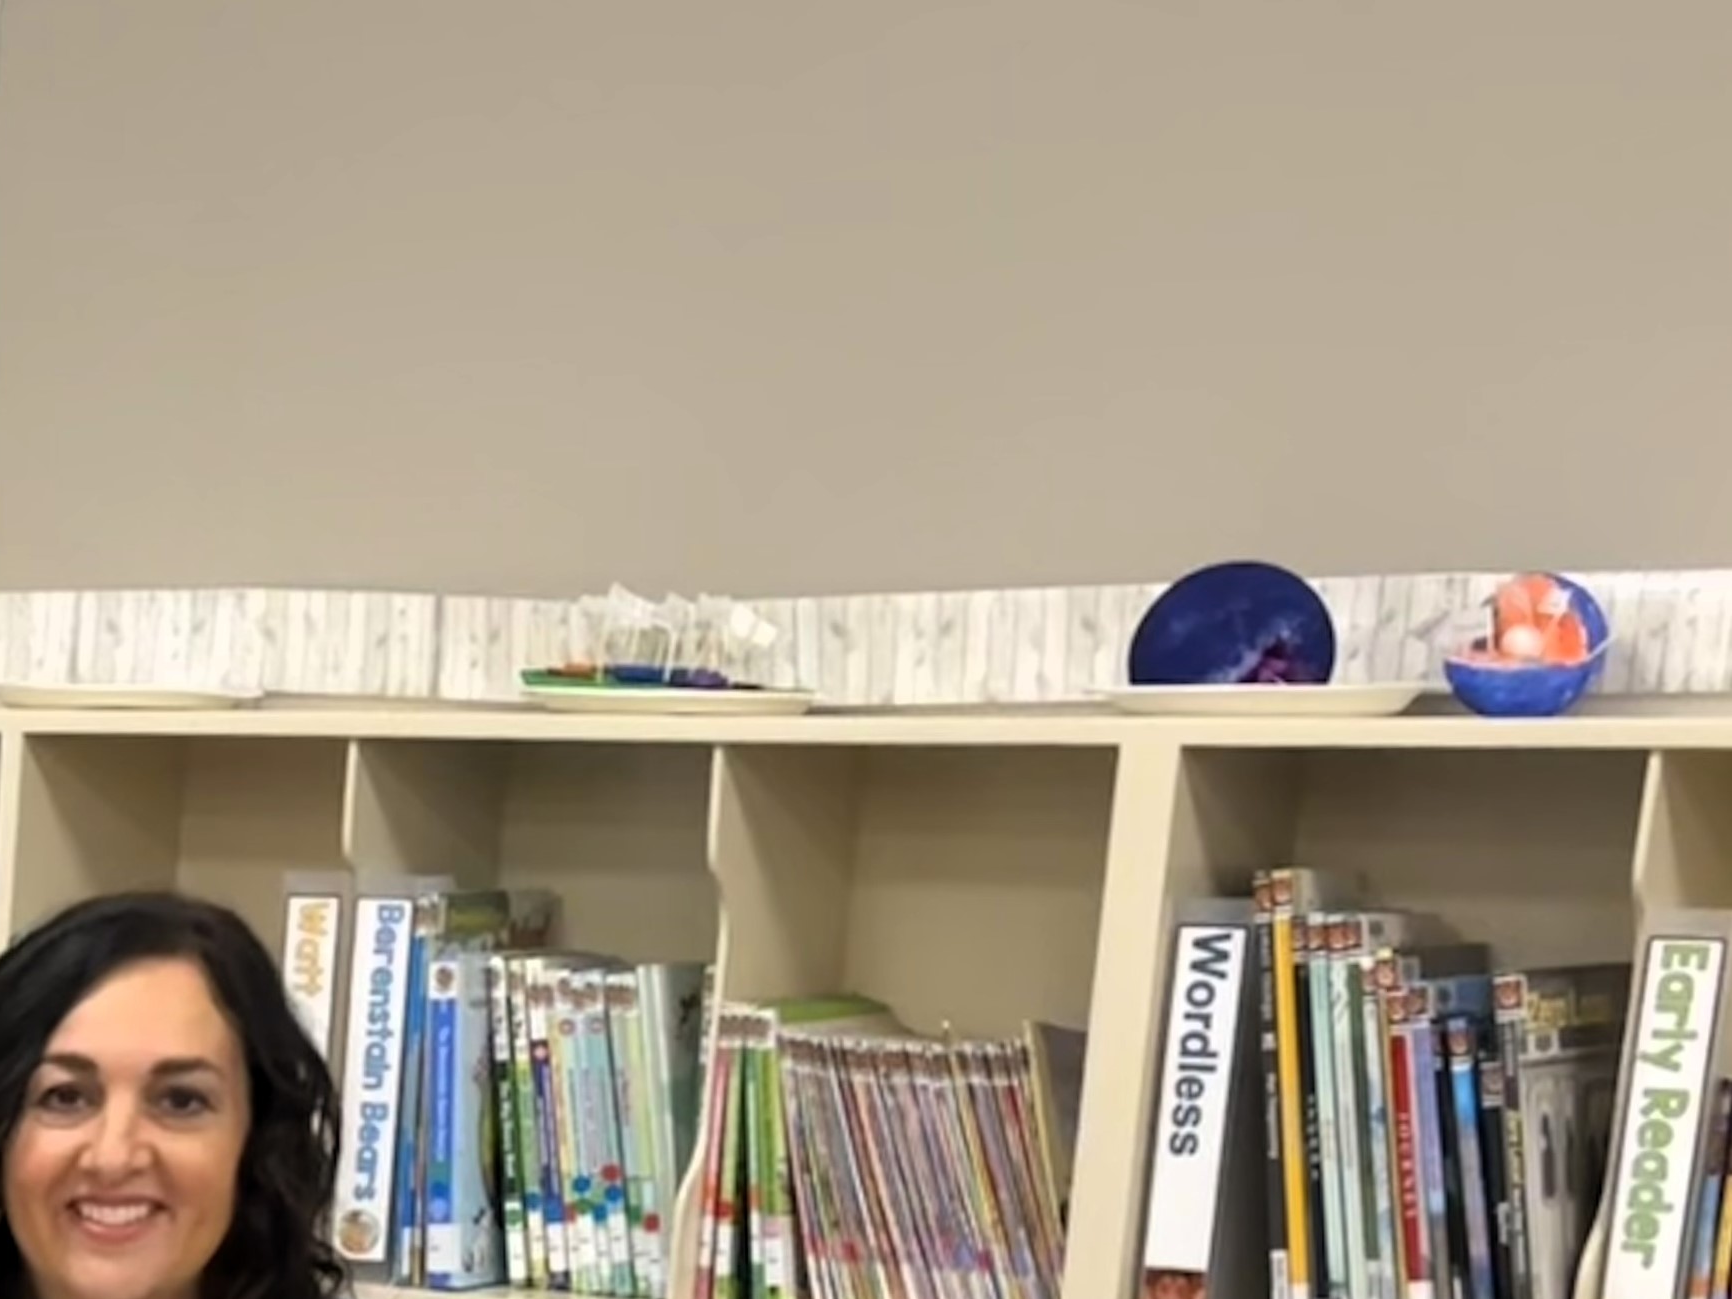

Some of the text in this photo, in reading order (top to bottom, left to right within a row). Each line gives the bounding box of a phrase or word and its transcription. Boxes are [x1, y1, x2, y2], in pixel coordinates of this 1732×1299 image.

[293, 901, 330, 998] Watt
[355, 903, 405, 1202] Berenstain Bears
[1169, 932, 1232, 1158] Wordless
[1398, 1112, 1417, 1219] JOURNEY
[1621, 943, 1710, 1270] Early Reader
